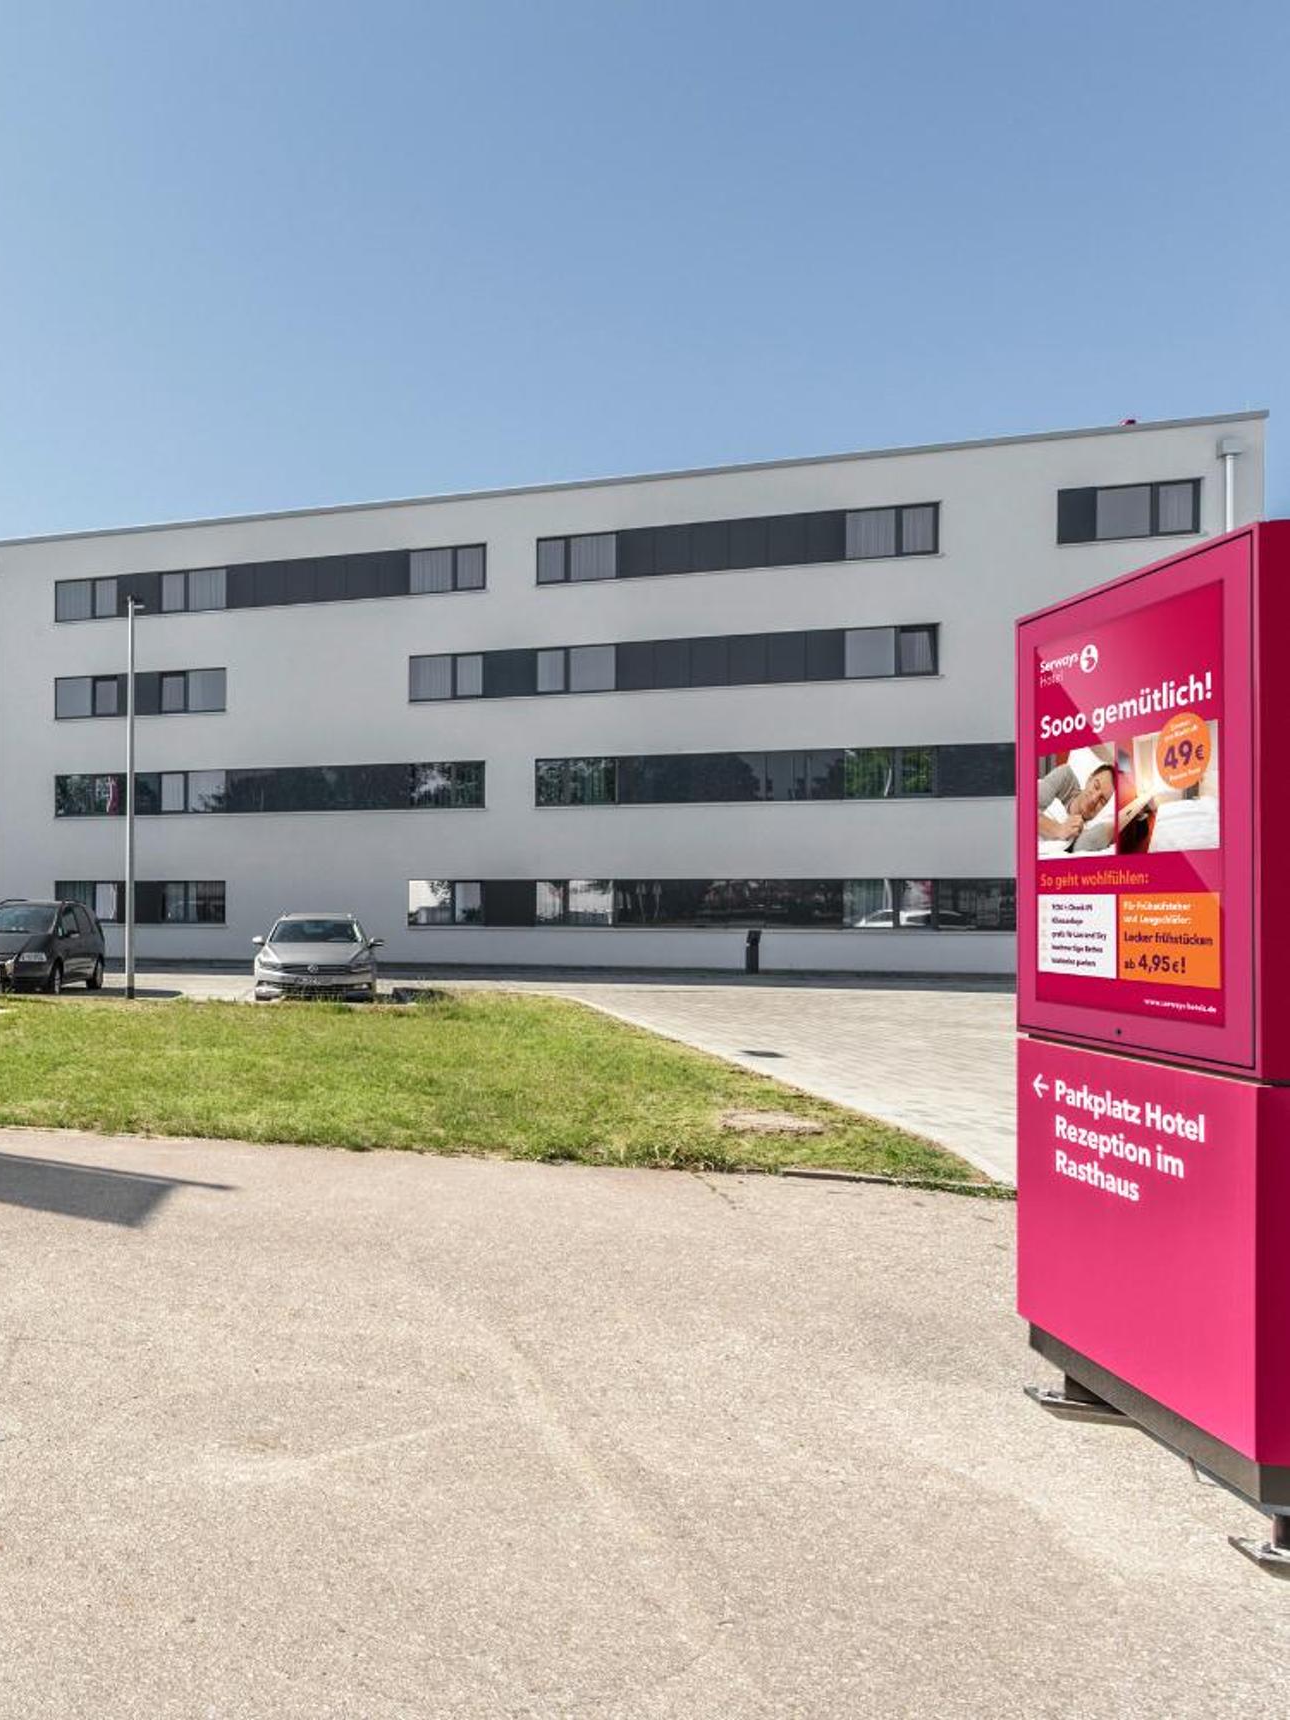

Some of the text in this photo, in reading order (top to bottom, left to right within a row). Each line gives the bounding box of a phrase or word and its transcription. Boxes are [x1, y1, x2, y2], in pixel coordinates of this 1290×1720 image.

[1040, 653, 1080, 674] Serways
[1040, 671, 1212, 740] Sooo gemütlich!
[1040, 869, 1149, 889] So geht wohlfühlen:
[1055, 1079, 1205, 1143] Parkplatz Hotel
[1055, 1115, 1185, 1178] Rezeption im
[1055, 1149, 1140, 1201] Rasthaus
